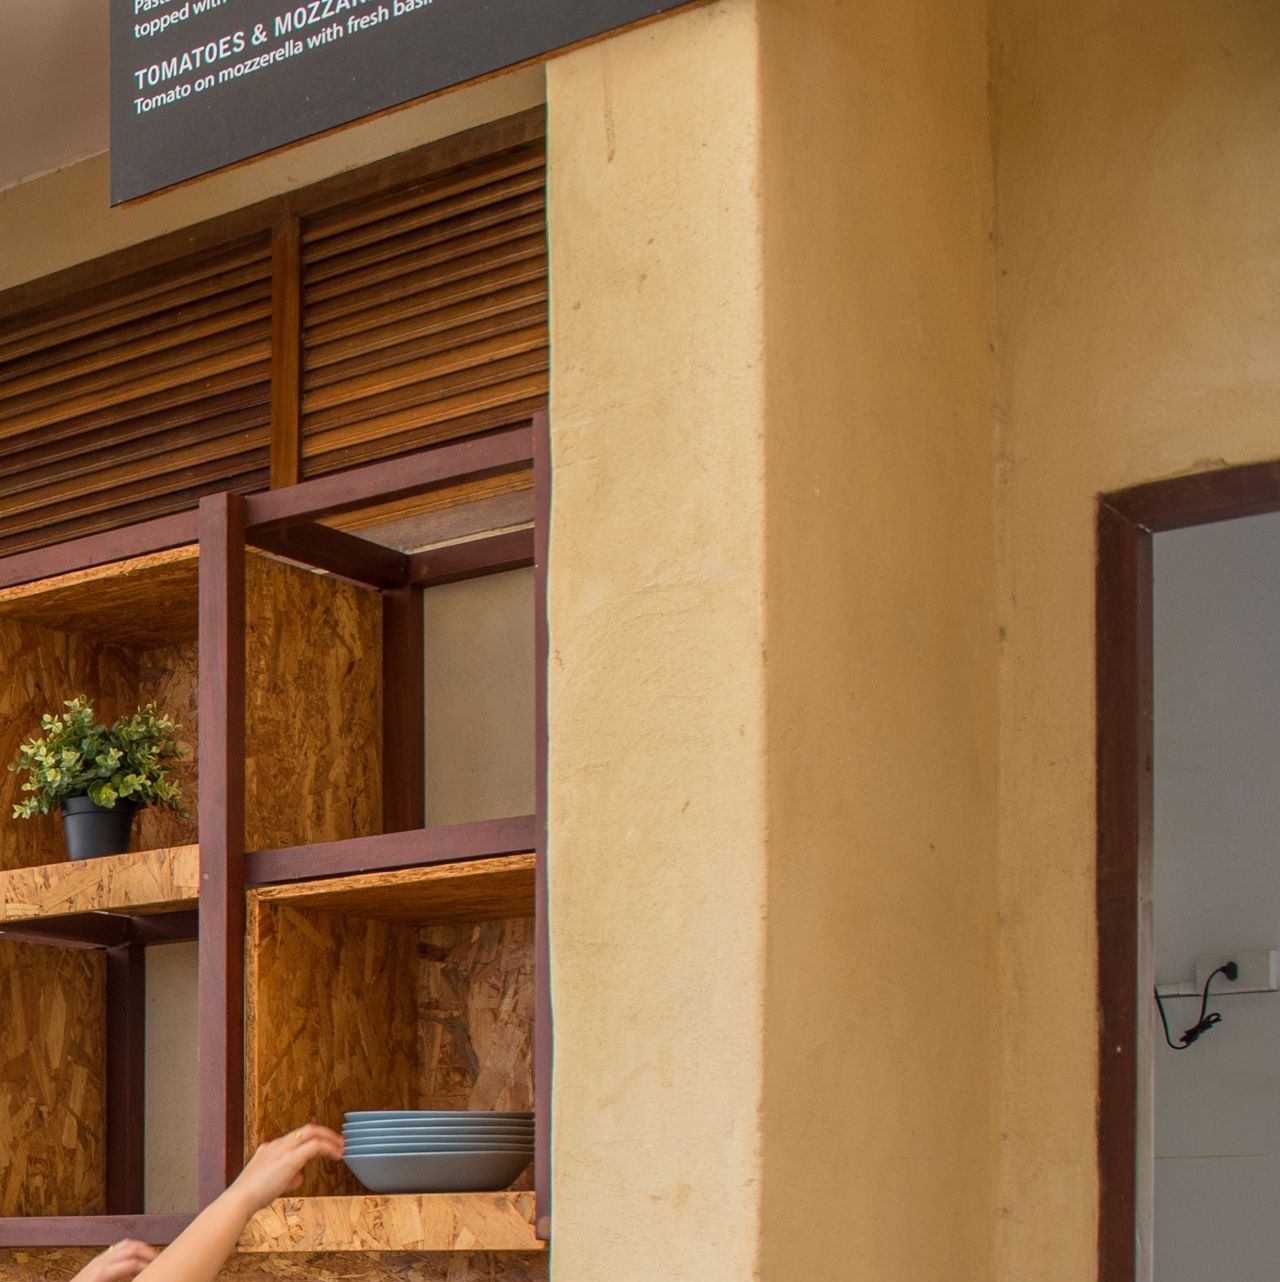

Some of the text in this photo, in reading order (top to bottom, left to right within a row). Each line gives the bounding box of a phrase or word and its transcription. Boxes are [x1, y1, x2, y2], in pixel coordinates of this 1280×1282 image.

[133, 5, 190, 39] topped
[133, 7, 390, 115] Tomato on mozzerella with fresh
[134, 25, 268, 90] TOMATOES &
